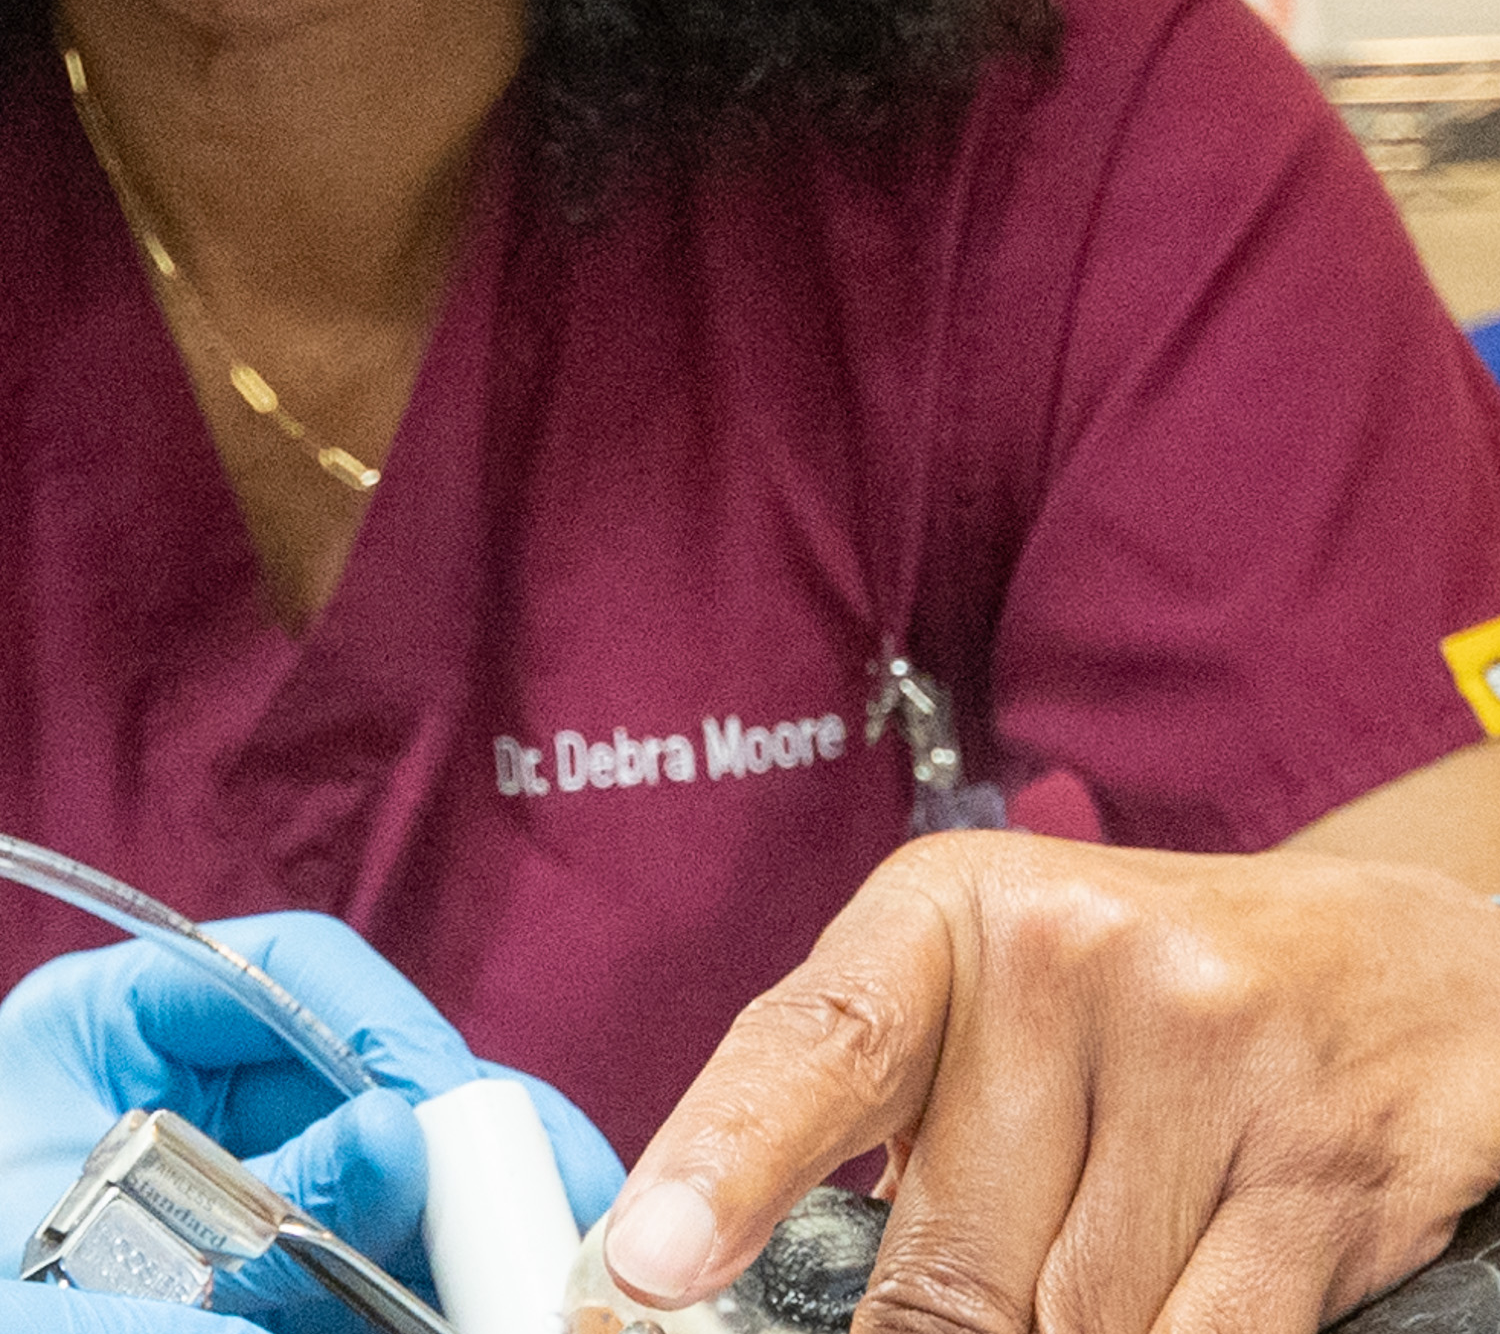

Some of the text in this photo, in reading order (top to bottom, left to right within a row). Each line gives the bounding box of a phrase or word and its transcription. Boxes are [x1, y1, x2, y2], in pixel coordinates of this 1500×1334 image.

[493, 712, 847, 796] Dr. Debra Moore
